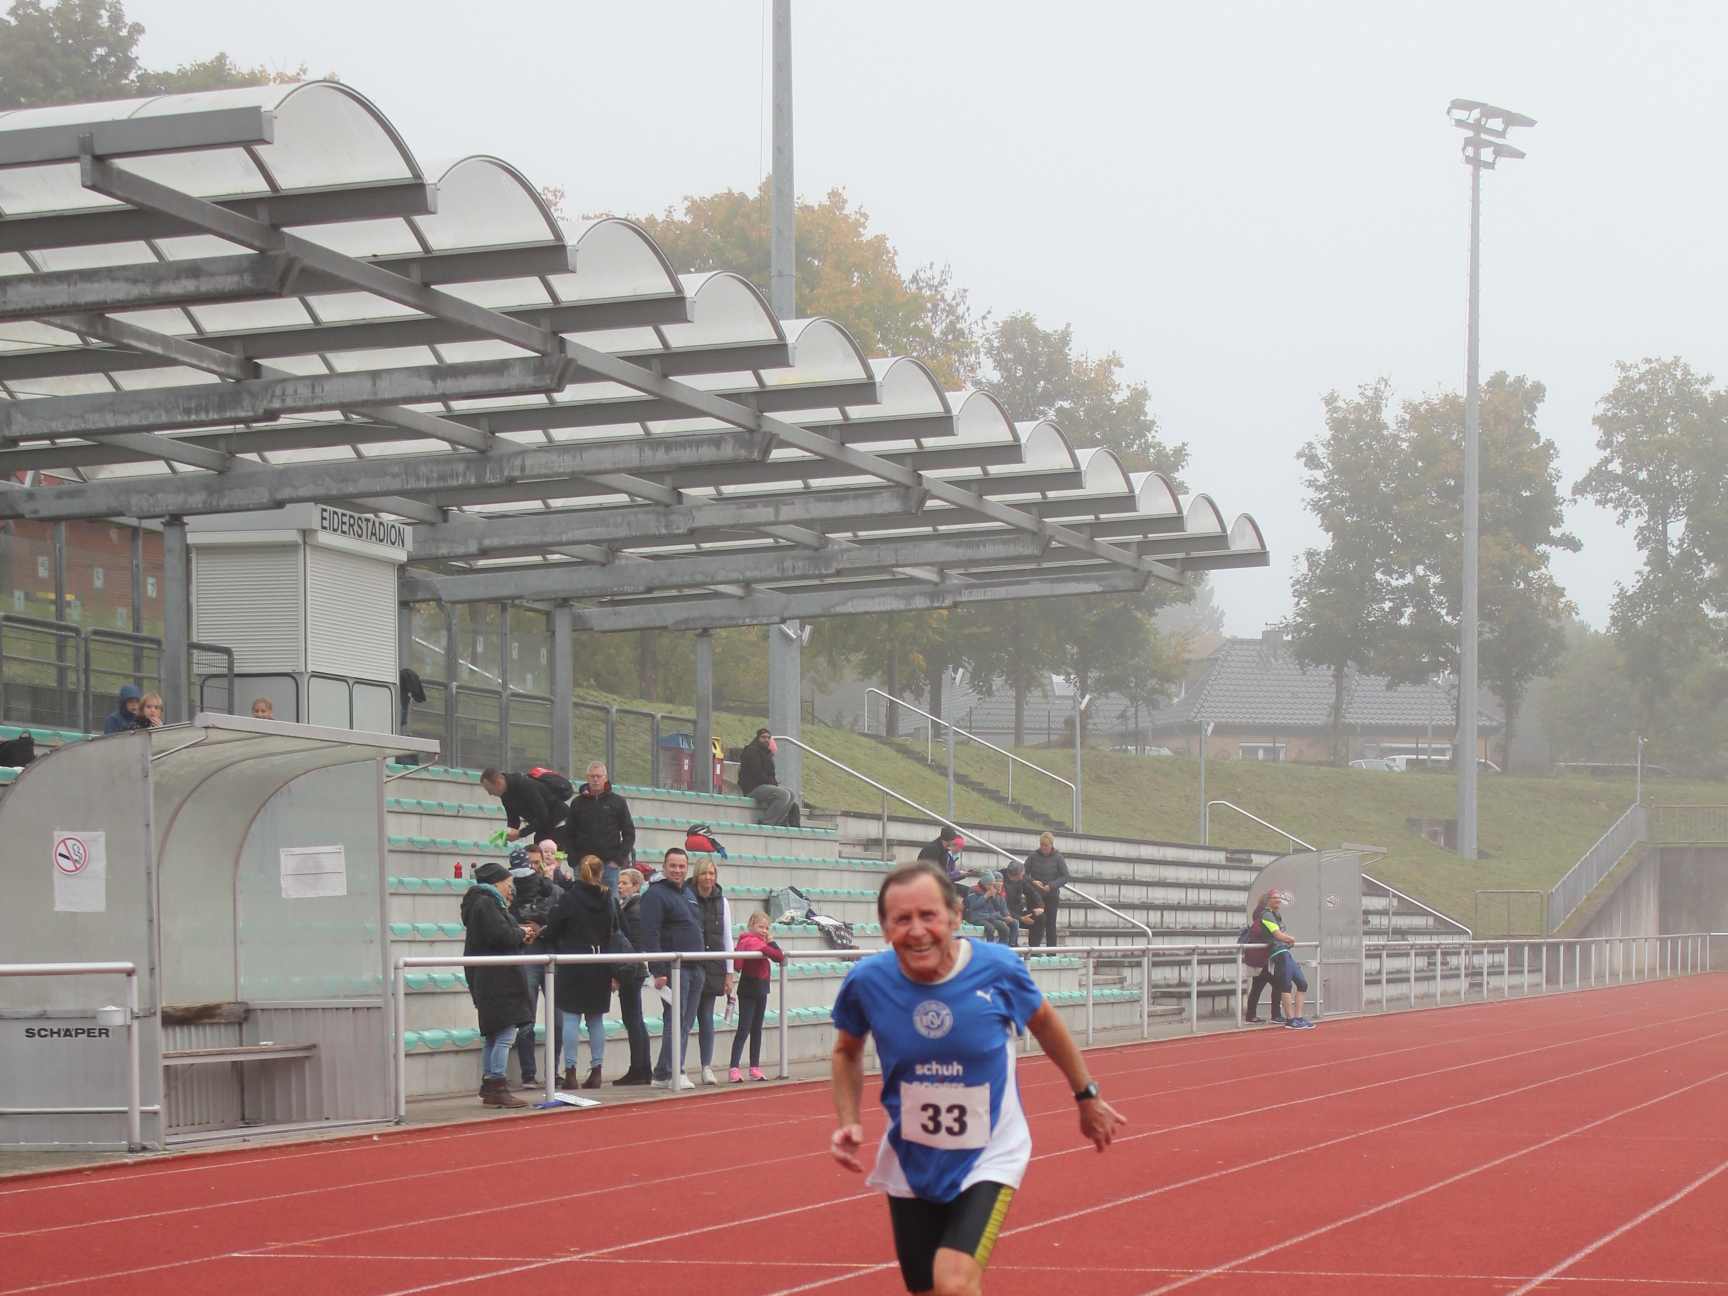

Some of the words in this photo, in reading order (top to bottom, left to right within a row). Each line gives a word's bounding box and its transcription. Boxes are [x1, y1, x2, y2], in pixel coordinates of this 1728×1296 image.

[320, 507, 405, 548] EIDERSTADION
[24, 1027, 110, 1039] SCHÄPER
[914, 1061, 963, 1076] schuh
[920, 1103, 968, 1137] 33
